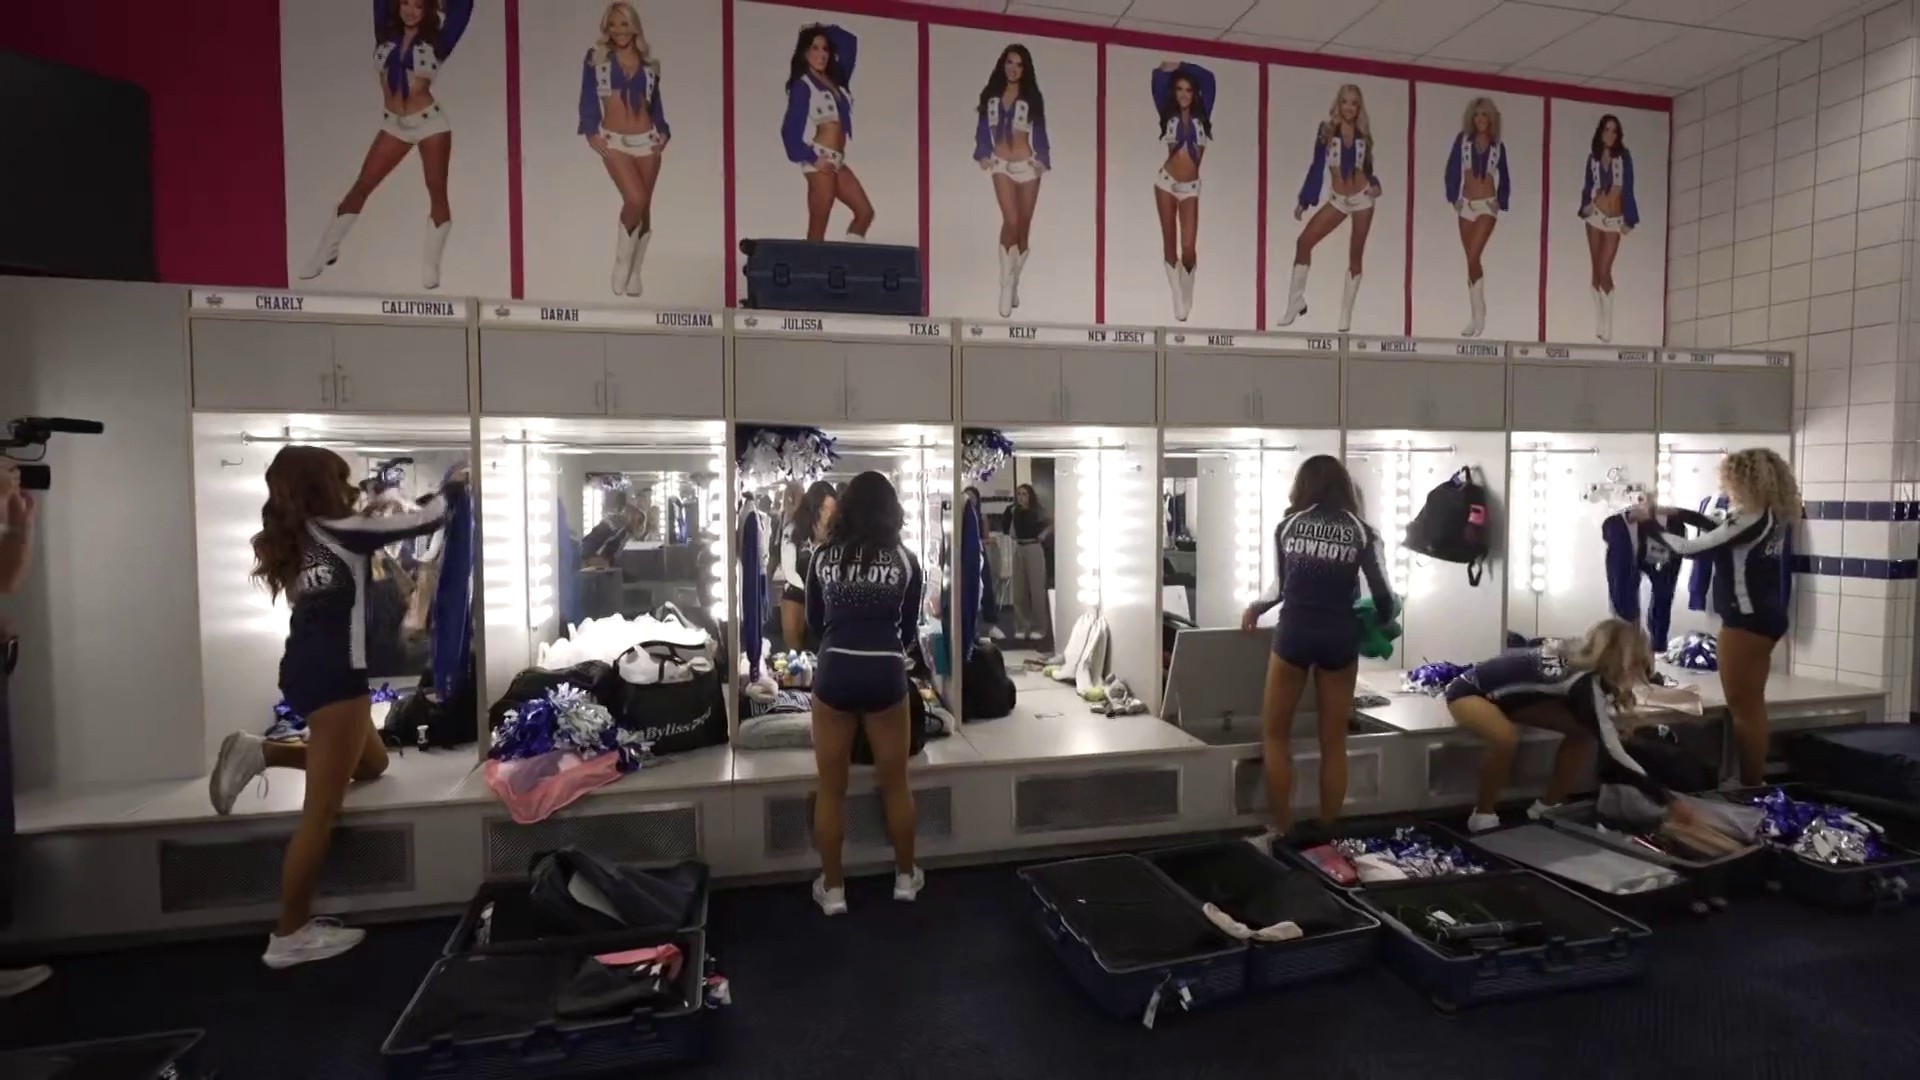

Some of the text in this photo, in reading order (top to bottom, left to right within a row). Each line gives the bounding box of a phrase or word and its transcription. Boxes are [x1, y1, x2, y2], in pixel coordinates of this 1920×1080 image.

[255, 295, 304, 311] CHARLY
[382, 300, 454, 316] CALIFORNIA
[540, 307, 579, 322] DARAH
[656, 312, 713, 327] LOUISIANA
[781, 317, 823, 332] JULISSA
[908, 323, 940, 336] TEXAS
[1009, 326, 1037, 340] KELLY
[1088, 331, 1145, 343] NEW JERSEY
[1208, 335, 1234, 346] MADIE
[1307, 339, 1332, 350] TEXAS
[1456, 344, 1498, 357] CALIFORNIA
[1295, 521, 1354, 543] DALLAS
[1285, 537, 1358, 563] COWBOYS
